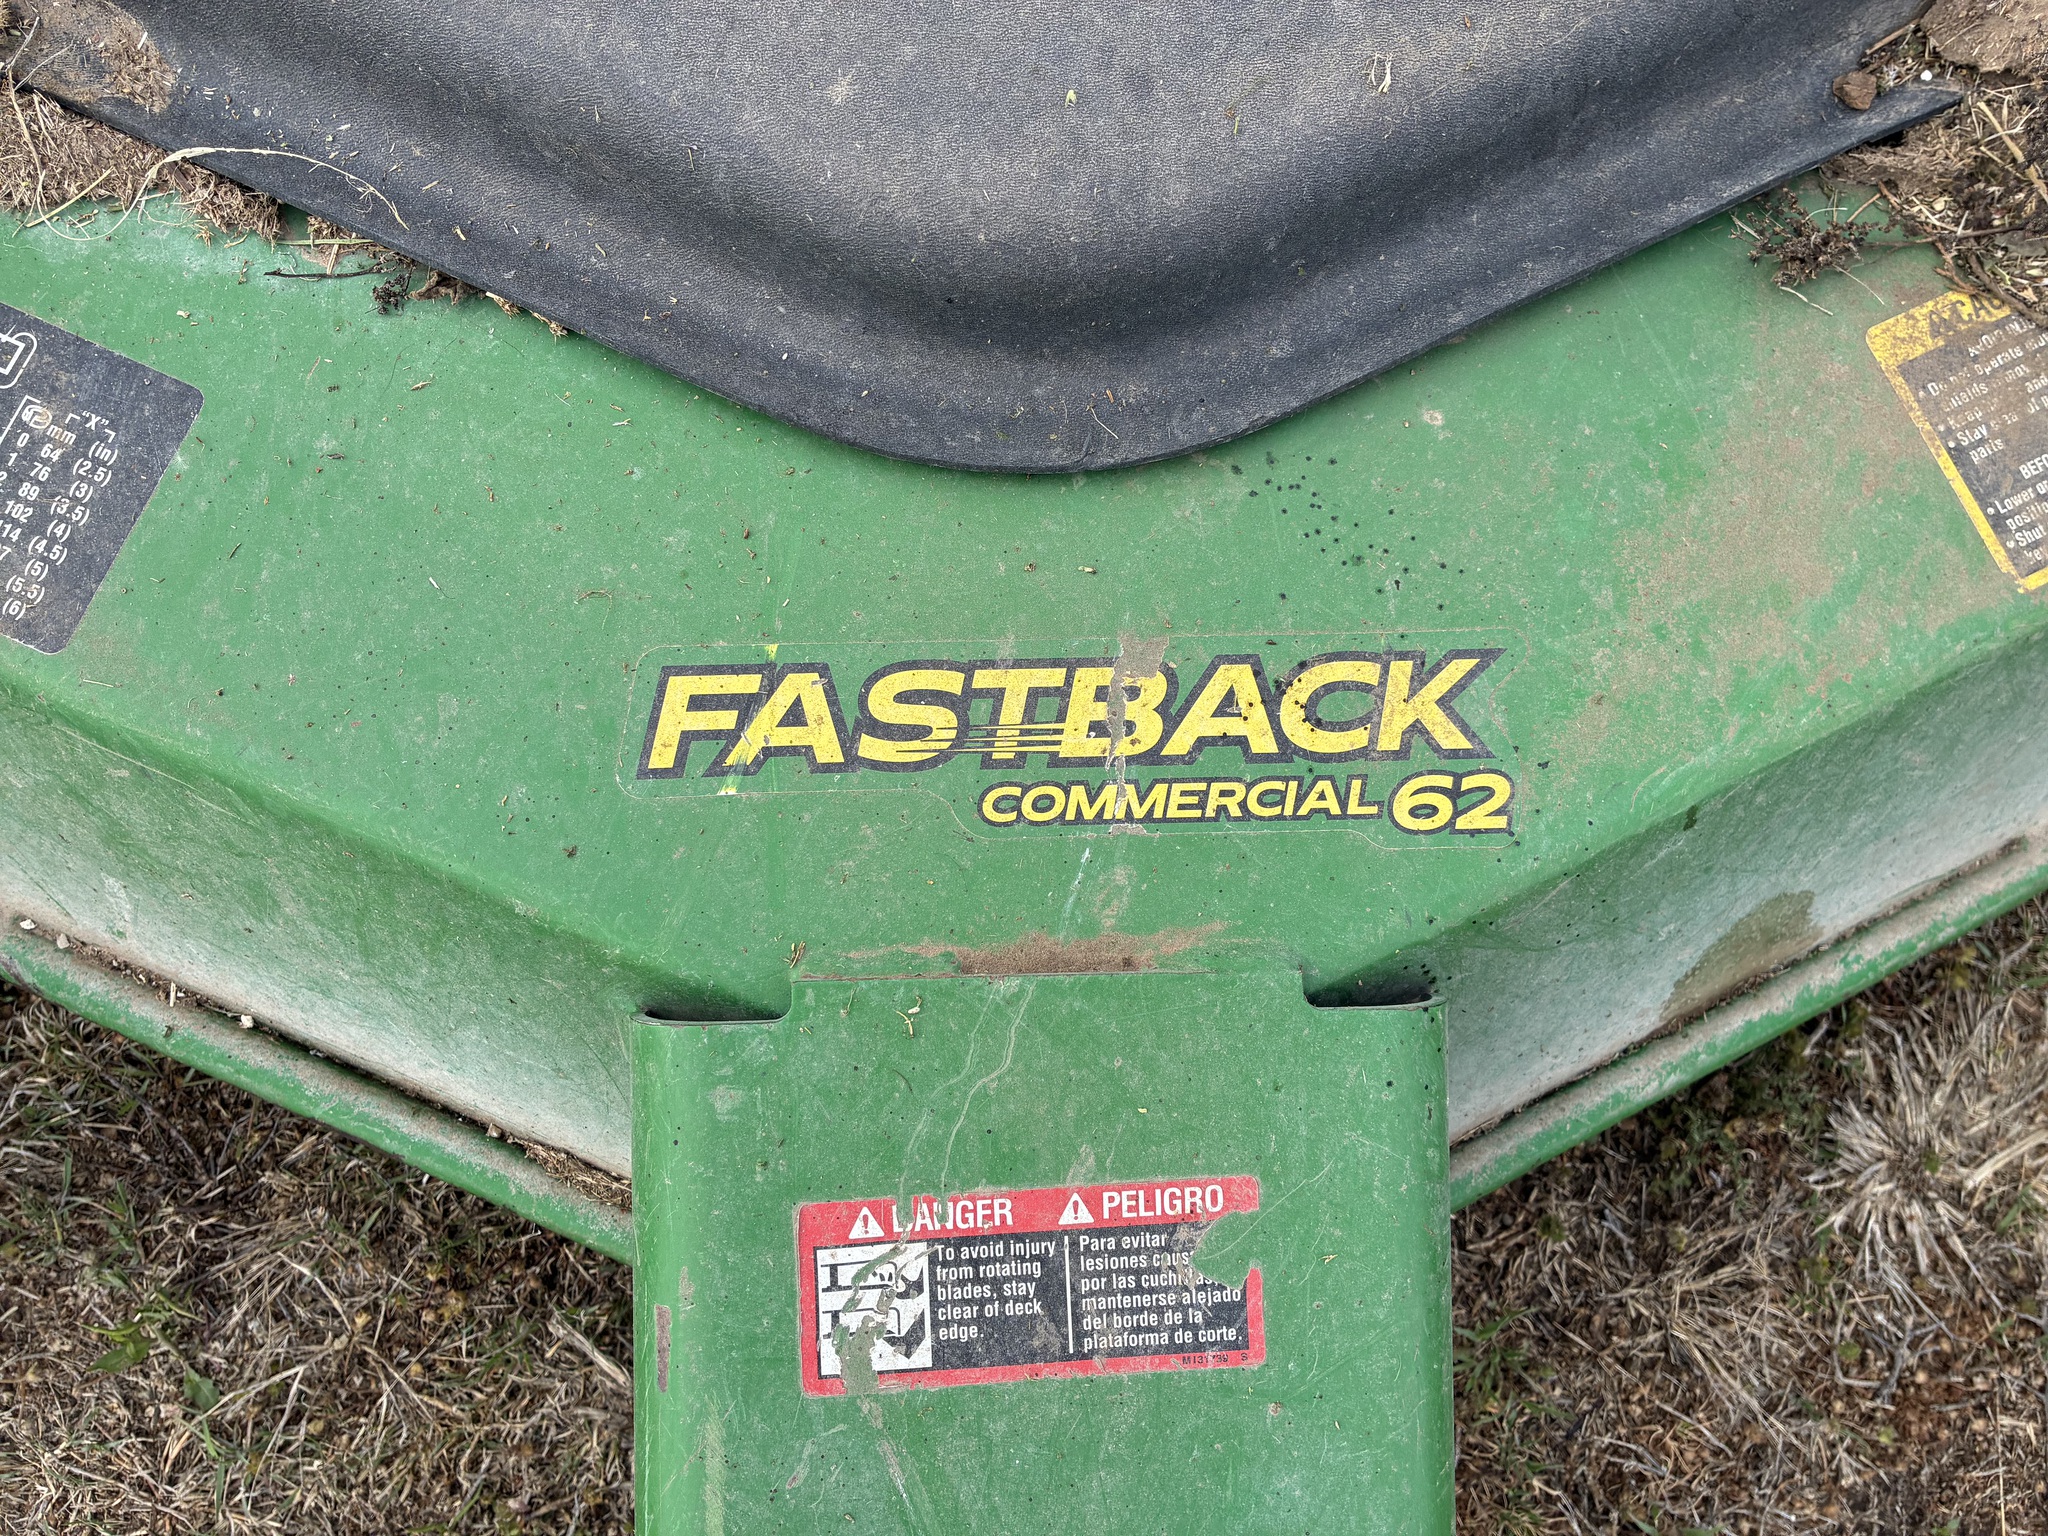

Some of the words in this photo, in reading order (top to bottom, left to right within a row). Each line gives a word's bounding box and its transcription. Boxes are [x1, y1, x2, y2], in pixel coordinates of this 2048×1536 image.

[46, 424, 77, 446] mm
[89, 440, 119, 467] (in)
[1957, 424, 1989, 446] Stay
[16, 432, 30, 448] 0
[41, 443, 65, 463] 64
[72, 457, 112, 488] (2.5)
[1969, 439, 2005, 464] parts
[7, 452, 18, 467] 1
[30, 461, 51, 482] 76
[69, 480, 94, 504] (3)
[18, 481, 40, 501] 89
[50, 495, 91, 527] (3.5)
[1995, 487, 2034, 514] Lower
[4, 500, 34, 523] 102
[47, 519, 72, 543] (4)
[2015, 525, 2047, 547] Shut
[28, 535, 68, 566] (4.5)
[24, 558, 49, 582] (5)
[5, 574, 46, 605] (5.5)
[2, 597, 27, 621] (6)
[637, 650, 1502, 779] FASTBACK
[978, 775, 1387, 828] COMMERCIAL
[1388, 769, 1516, 836] 62
[1102, 1184, 1224, 1220] PELIGRO
[936, 1244, 955, 1262] To
[960, 1240, 1004, 1258] avoid
[1009, 1238, 1056, 1259] injury
[1079, 1234, 1116, 1252] Para
[1121, 1231, 1167, 1249] evitar
[936, 1265, 974, 1282] from
[979, 1260, 1042, 1279] rotating
[1080, 1253, 1148, 1272] lesiones
[1152, 1249, 1195, 1267] caus
[937, 1284, 998, 1301] blades,
[1003, 1281, 1036, 1299] stay
[1081, 1276, 1107, 1295] por
[1112, 1273, 1136, 1289] las
[938, 1303, 979, 1321] clear
[984, 1300, 1001, 1318] of
[1004, 1298, 1043, 1316] deck
[1081, 1293, 1176, 1311] mantenerse
[1181, 1288, 1242, 1306] alejado
[1082, 1314, 1107, 1331] del
[1113, 1310, 1159, 1329] borde
[1164, 1309, 1183, 1325] de
[1188, 1308, 1203, 1324] la
[938, 1325, 985, 1343] edge.
[1083, 1330, 1169, 1352] plataforma
[1173, 1328, 1193, 1344] de
[1197, 1326, 1243, 1343] corte.
